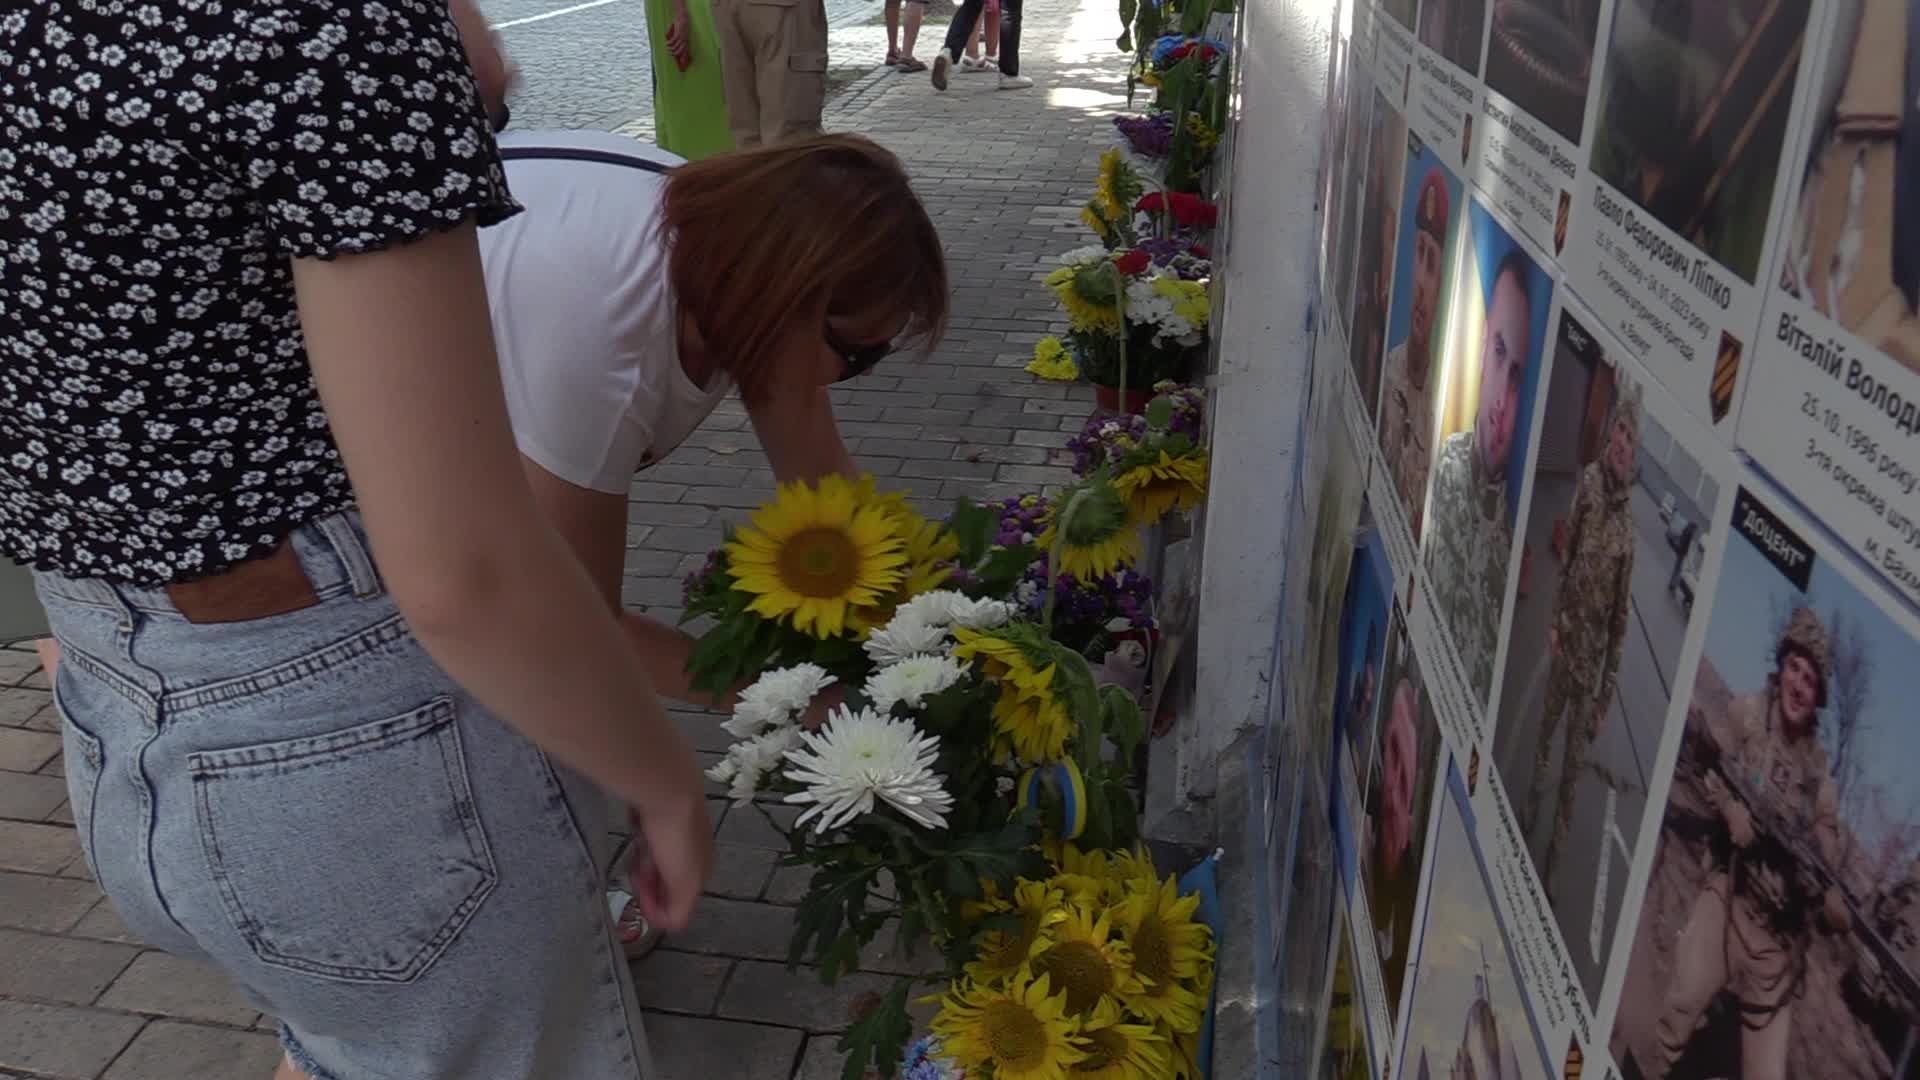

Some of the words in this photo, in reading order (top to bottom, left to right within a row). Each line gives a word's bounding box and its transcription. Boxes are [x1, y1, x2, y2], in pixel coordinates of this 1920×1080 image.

[1593, 185, 1623, 227] Павло
[1623, 209, 1690, 279] Федорович
[1688, 258, 1731, 310] Ліпко
[1776, 312, 1846, 381] Віталій
[1804, 437, 1832, 472] 3-тя
[1832, 465, 1886, 516] окрема
[1878, 454, 1917, 495] року
[1741, 502, 1807, 567] "ДОЦЕНТ"
